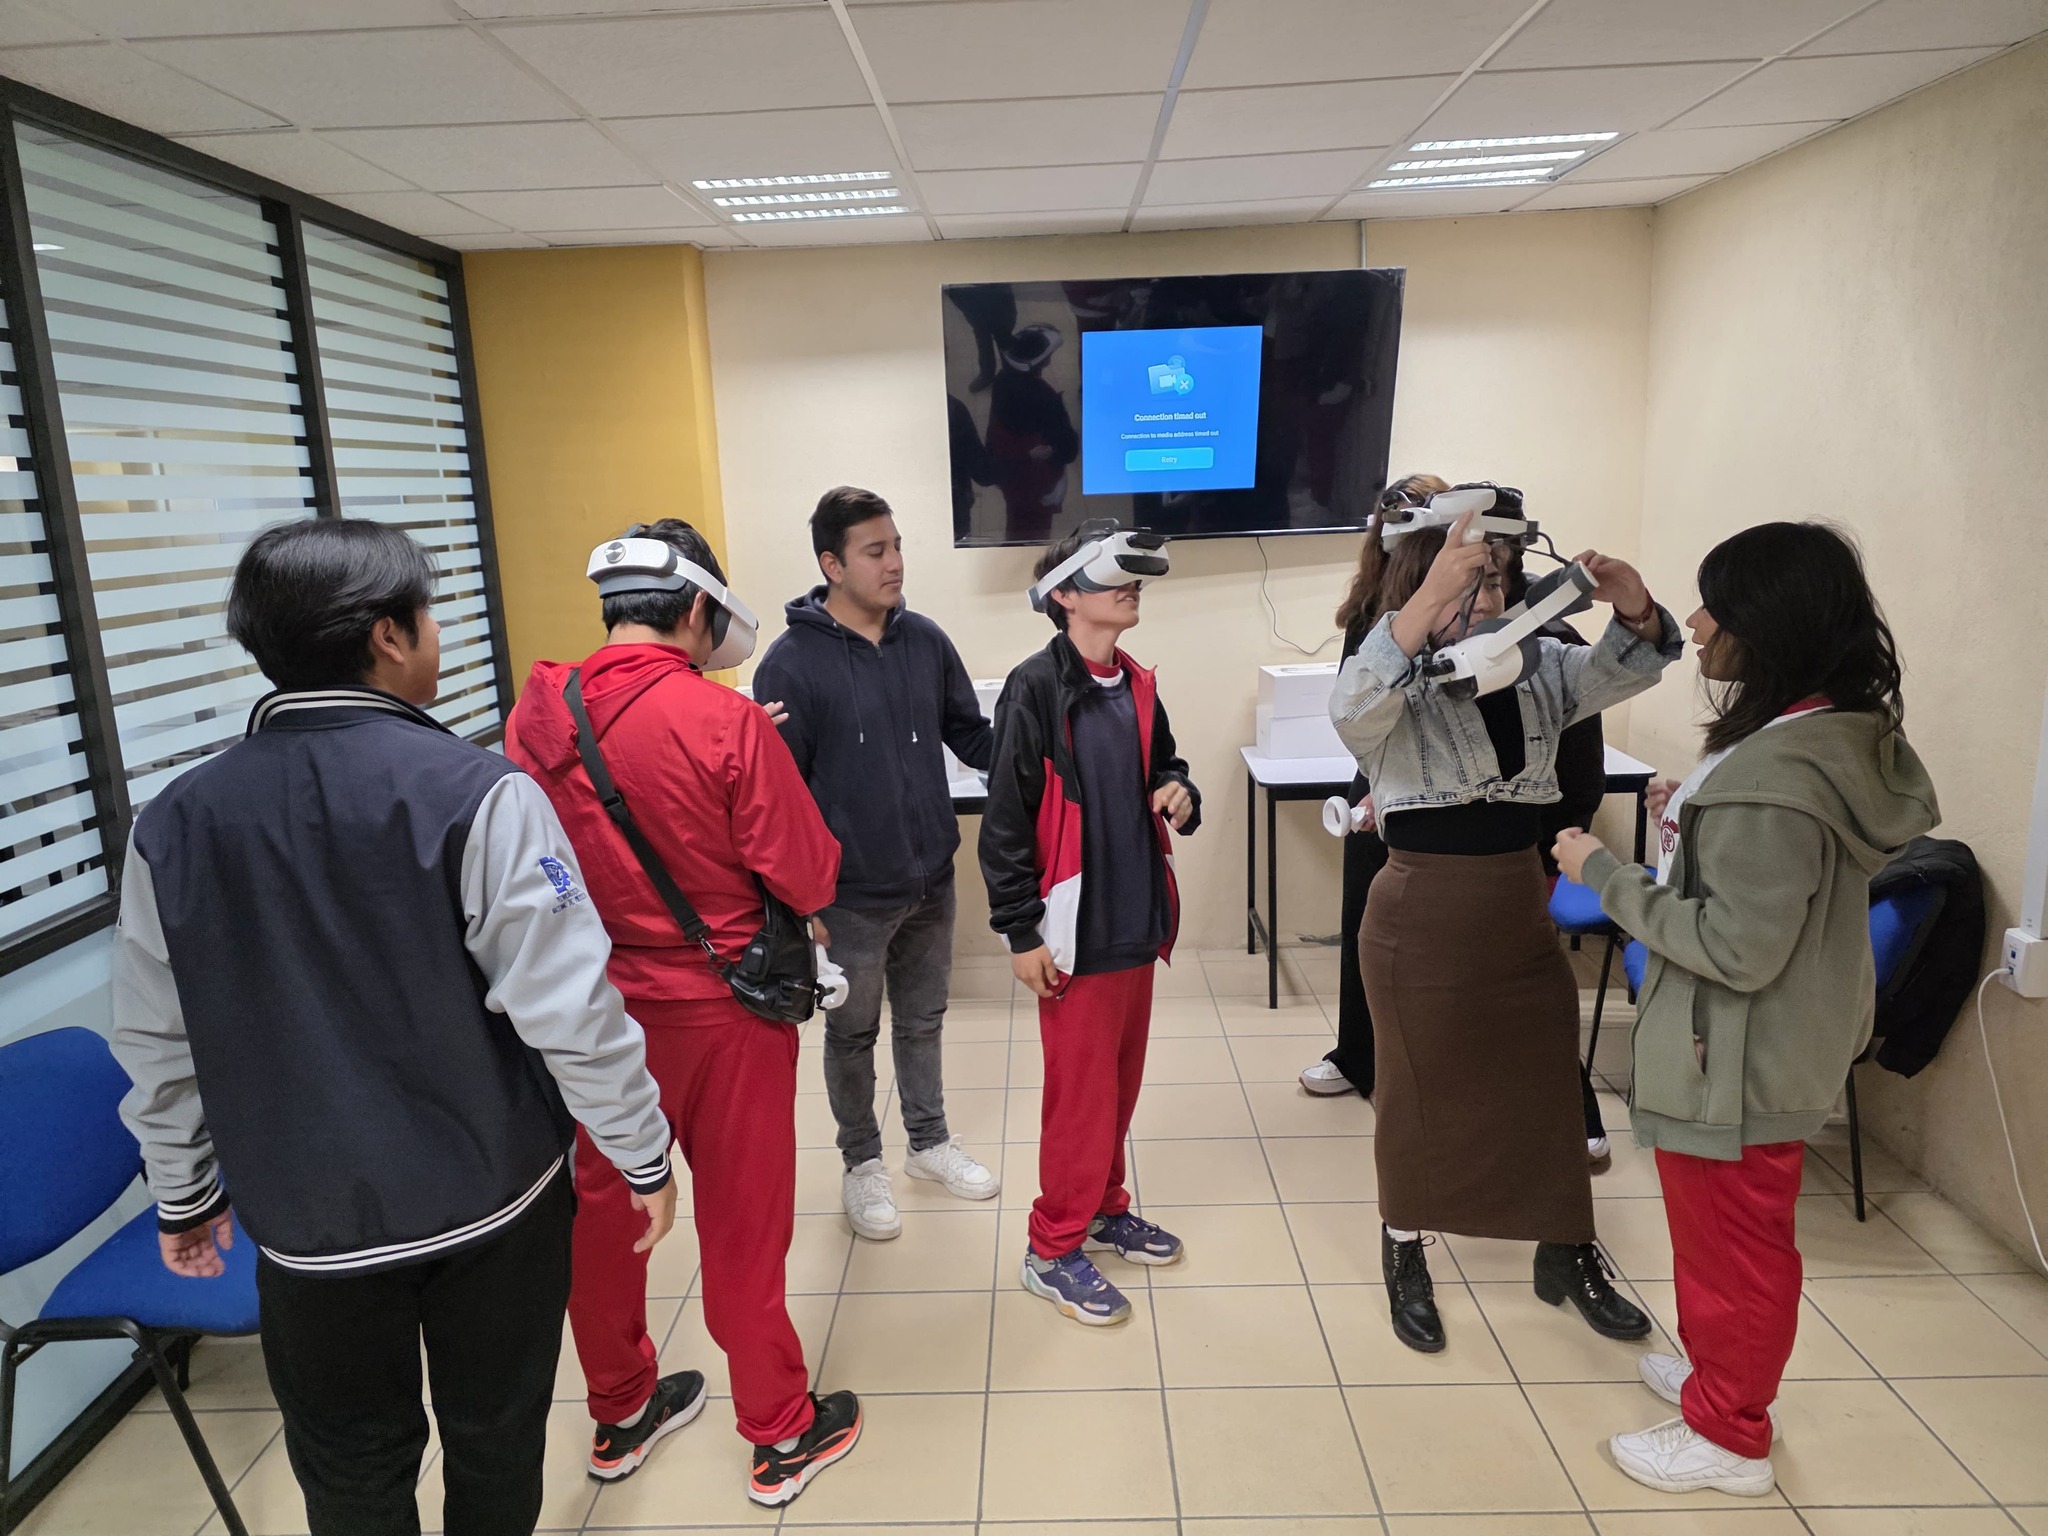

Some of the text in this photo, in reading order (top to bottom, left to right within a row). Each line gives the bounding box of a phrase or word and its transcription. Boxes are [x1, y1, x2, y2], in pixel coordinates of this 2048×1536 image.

[1134, 412, 1207, 422] Connection timed out
[1161, 456, 1177, 464] Retry
